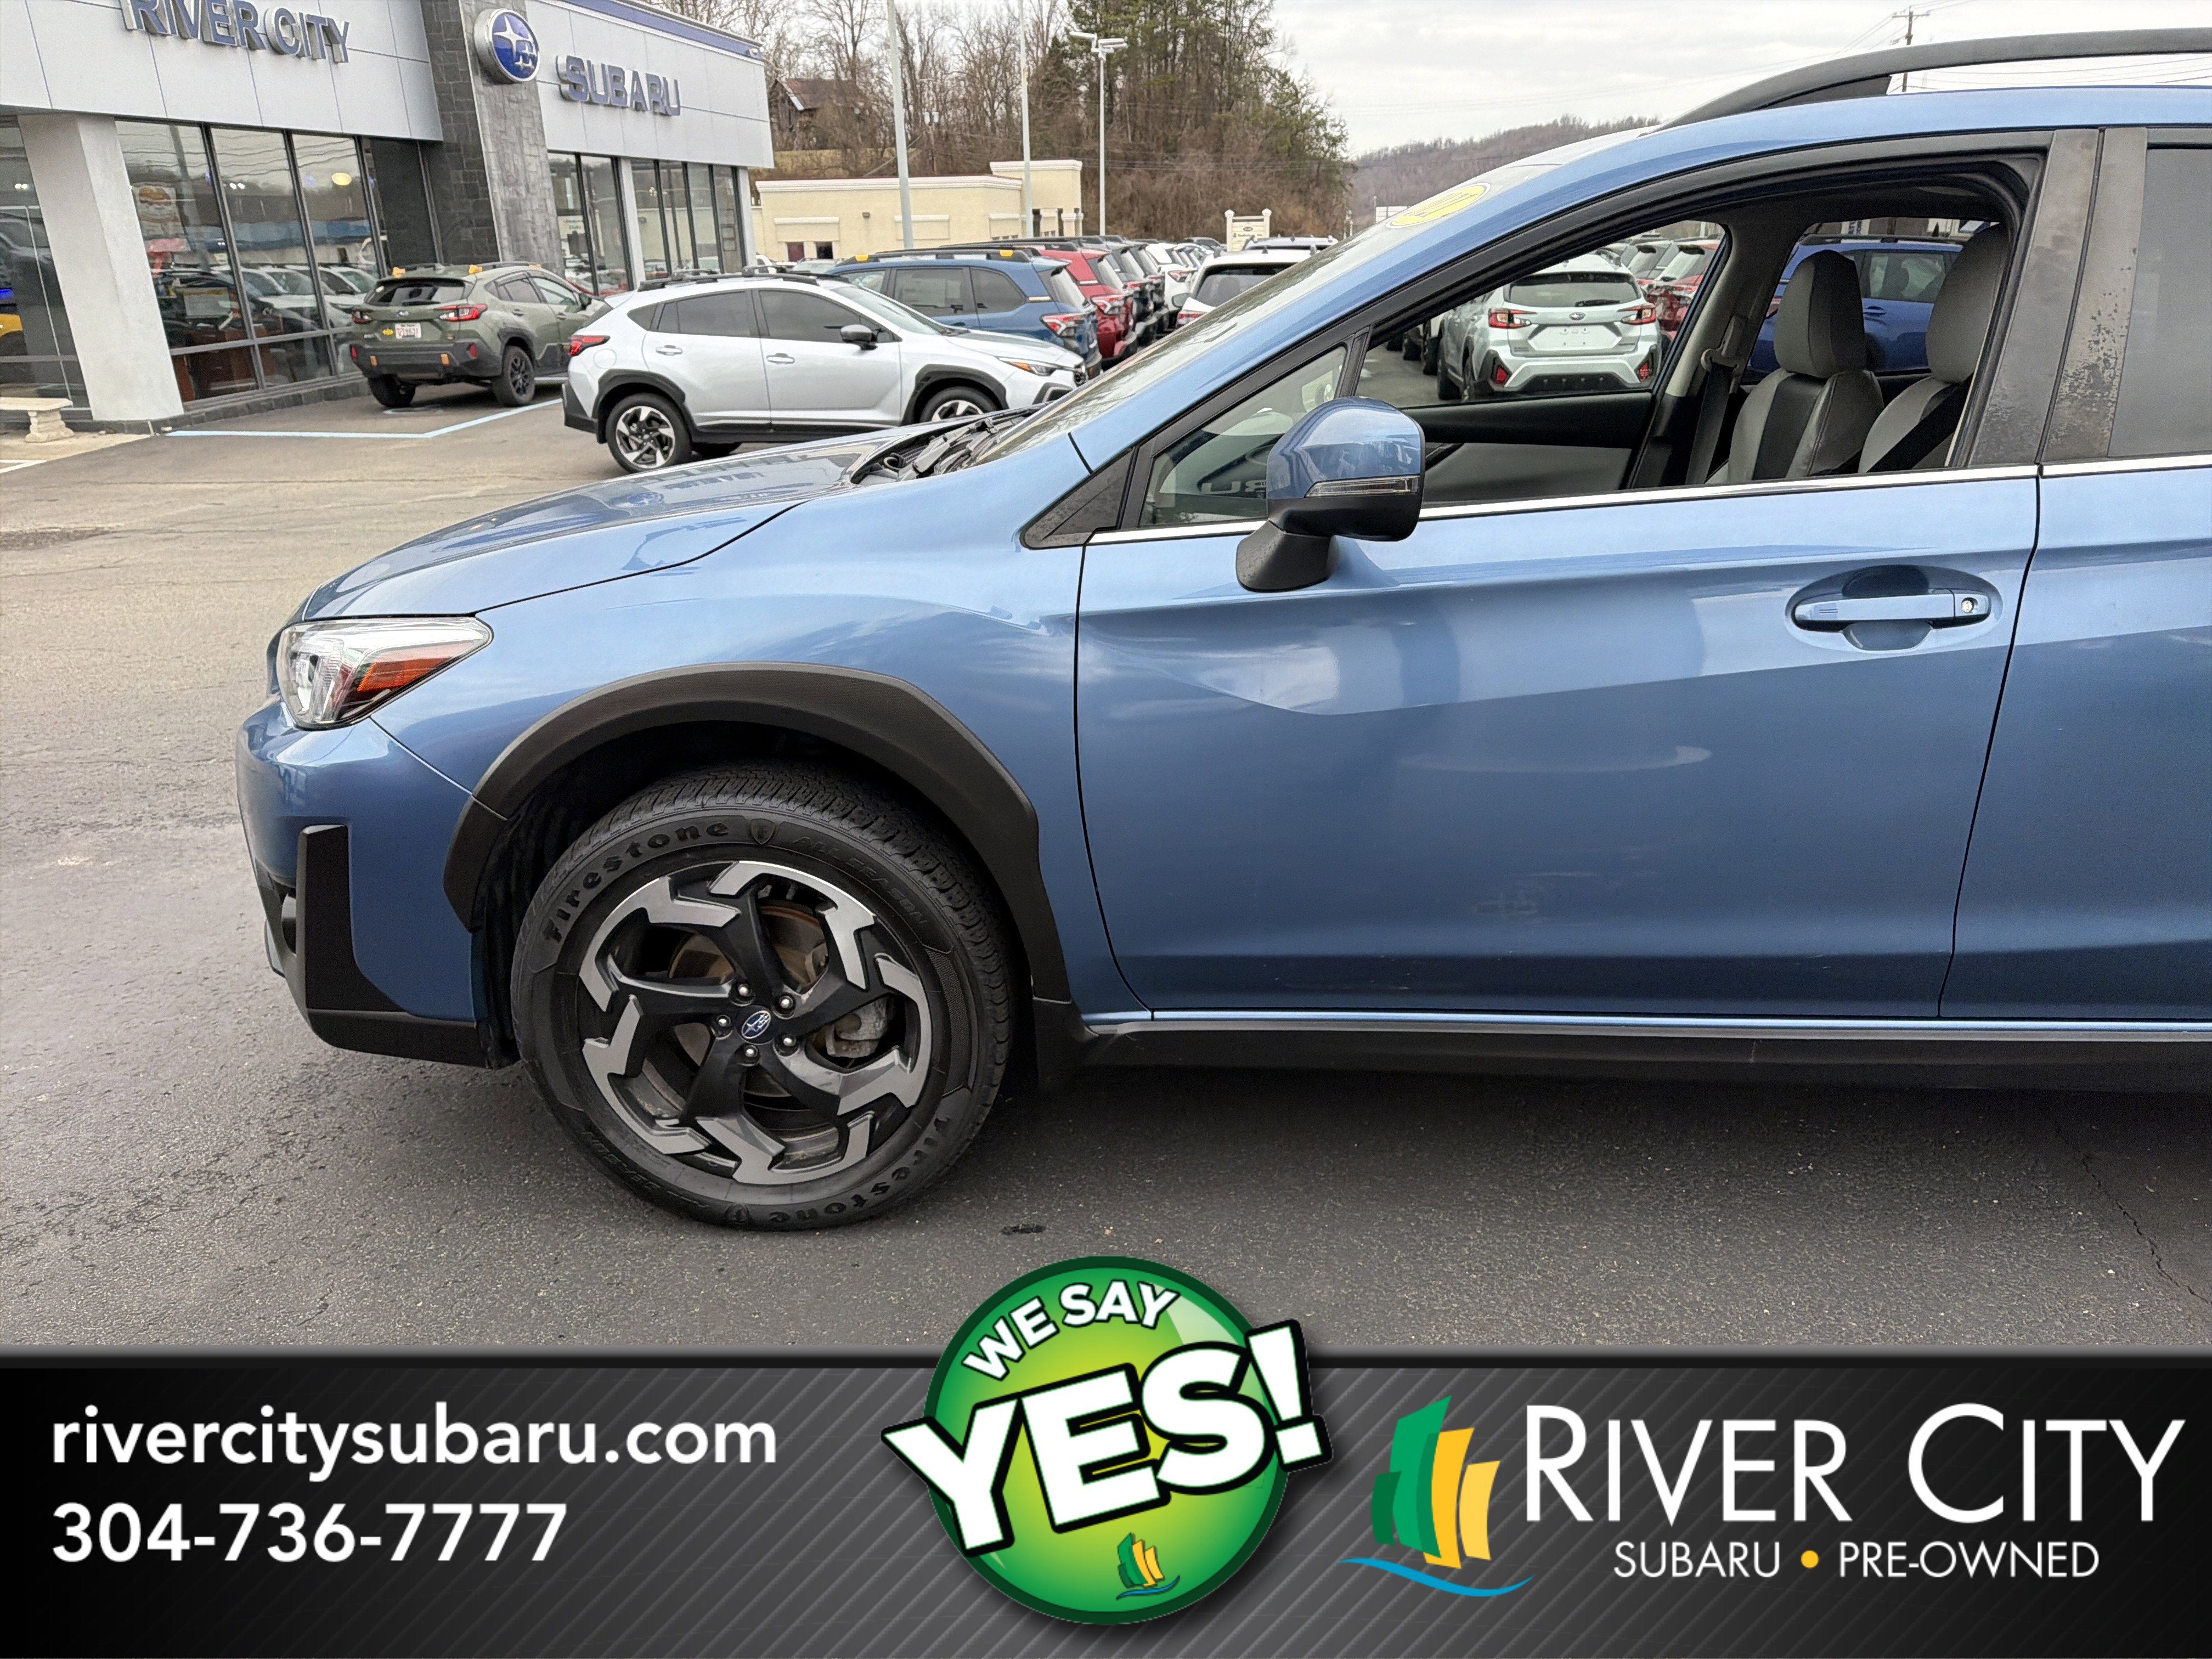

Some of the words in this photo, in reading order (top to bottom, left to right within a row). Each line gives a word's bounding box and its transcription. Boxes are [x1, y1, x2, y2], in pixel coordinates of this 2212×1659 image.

[122, 0, 266, 50] RIVER
[264, 7, 350, 63] CITY
[556, 55, 681, 116] SUBARU
[544, 822, 729, 943] Firestone
